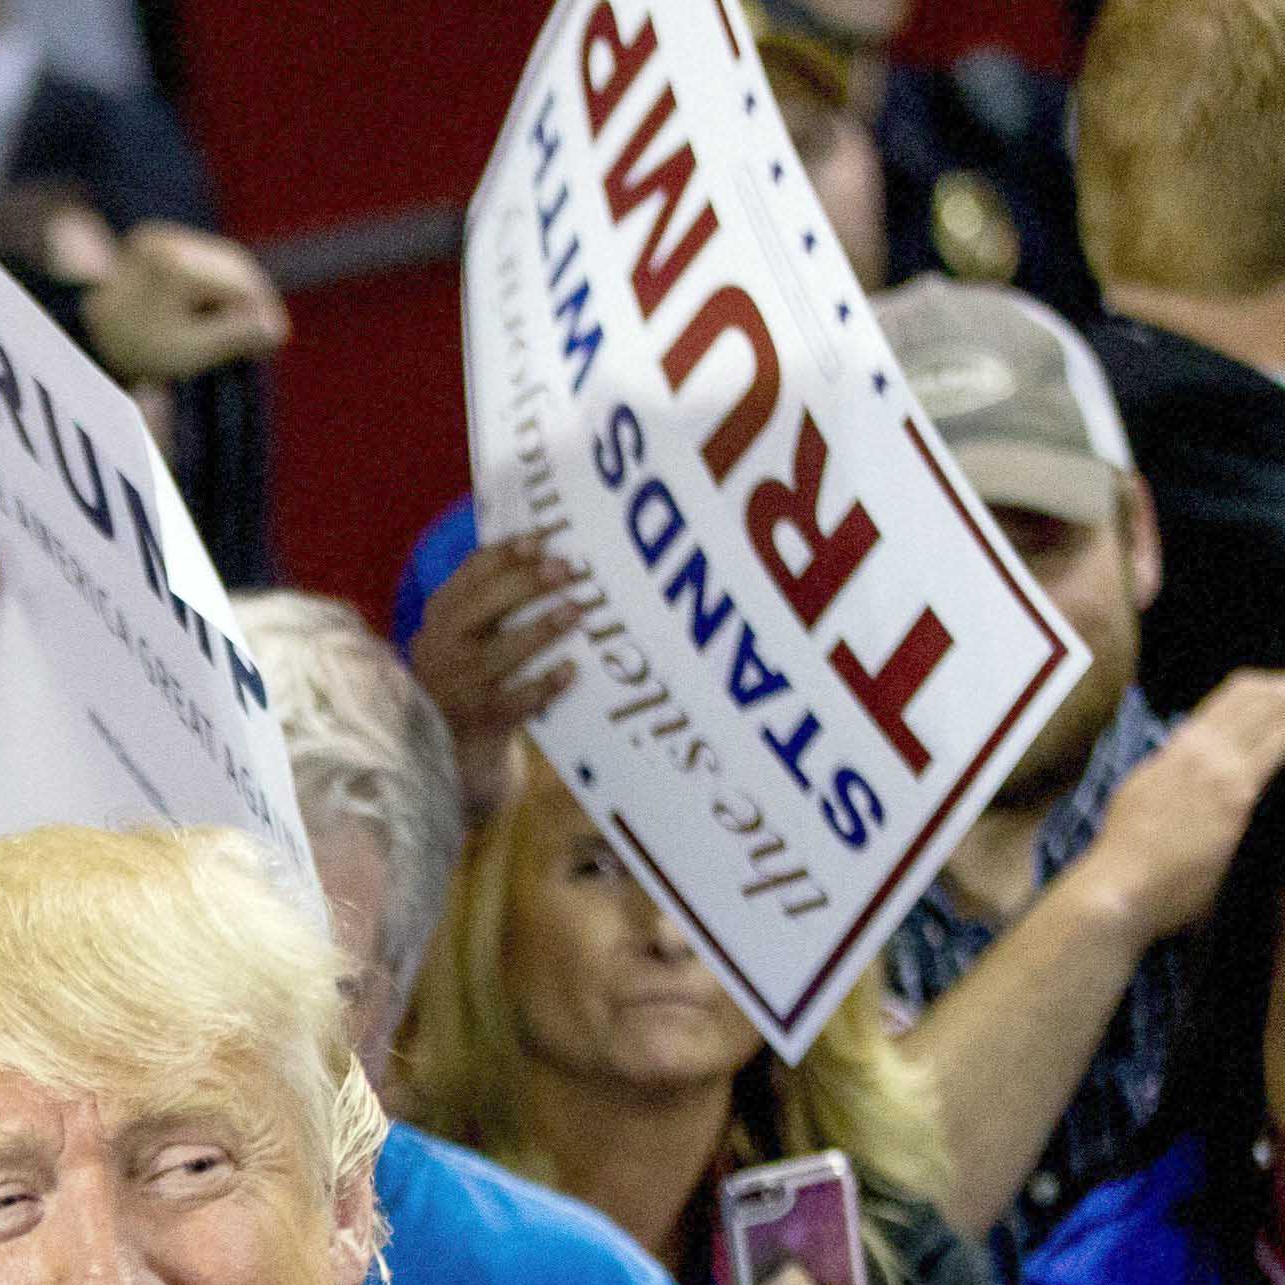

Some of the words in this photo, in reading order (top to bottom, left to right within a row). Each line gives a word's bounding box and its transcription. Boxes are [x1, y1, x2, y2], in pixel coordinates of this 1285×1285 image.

[529, 88, 604, 397] WITH
[579, 0, 955, 775] TRUMP
[593, 402, 886, 851] STANDS
[712, 796, 830, 922] the
